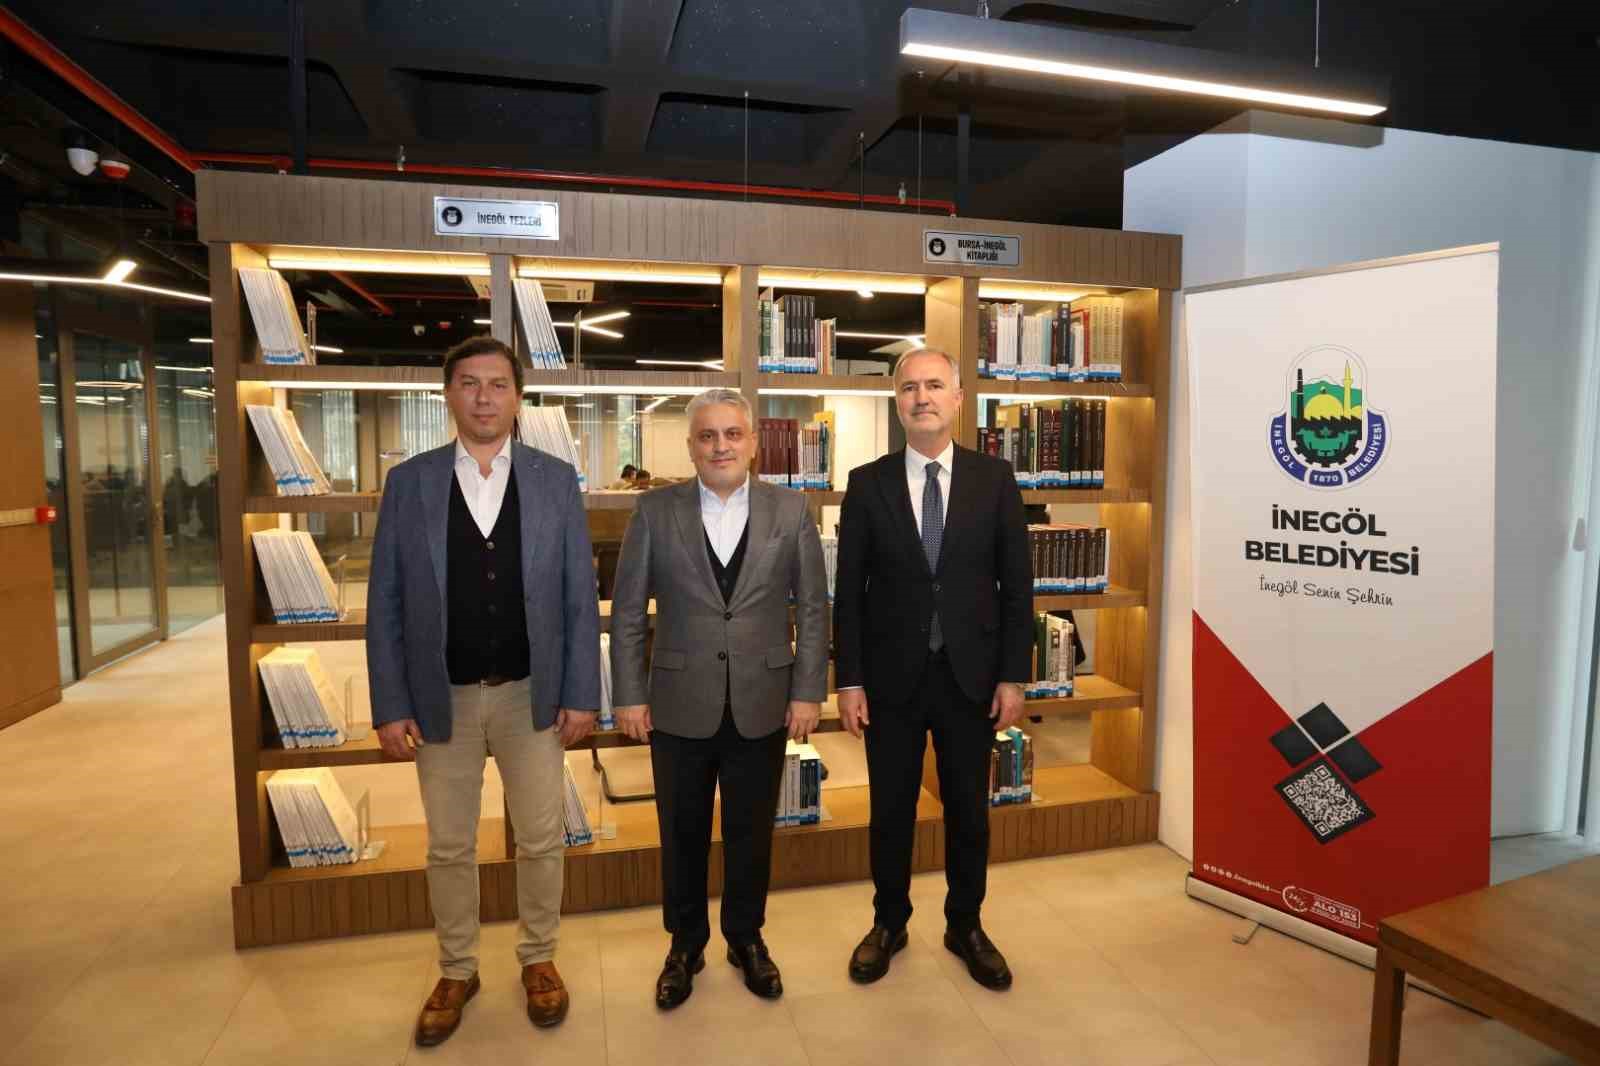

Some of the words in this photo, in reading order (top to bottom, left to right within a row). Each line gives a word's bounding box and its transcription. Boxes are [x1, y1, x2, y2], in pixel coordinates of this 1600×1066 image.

[1271, 504, 1387, 537] İNEGÖL
[1245, 540, 1419, 576] BELEDİYESİ
[1259, 573, 1299, 597] İnegöl
[1303, 583, 1341, 600] Senin
[1346, 587, 1393, 607] Şehrin
[1313, 901, 1337, 914] ALO
